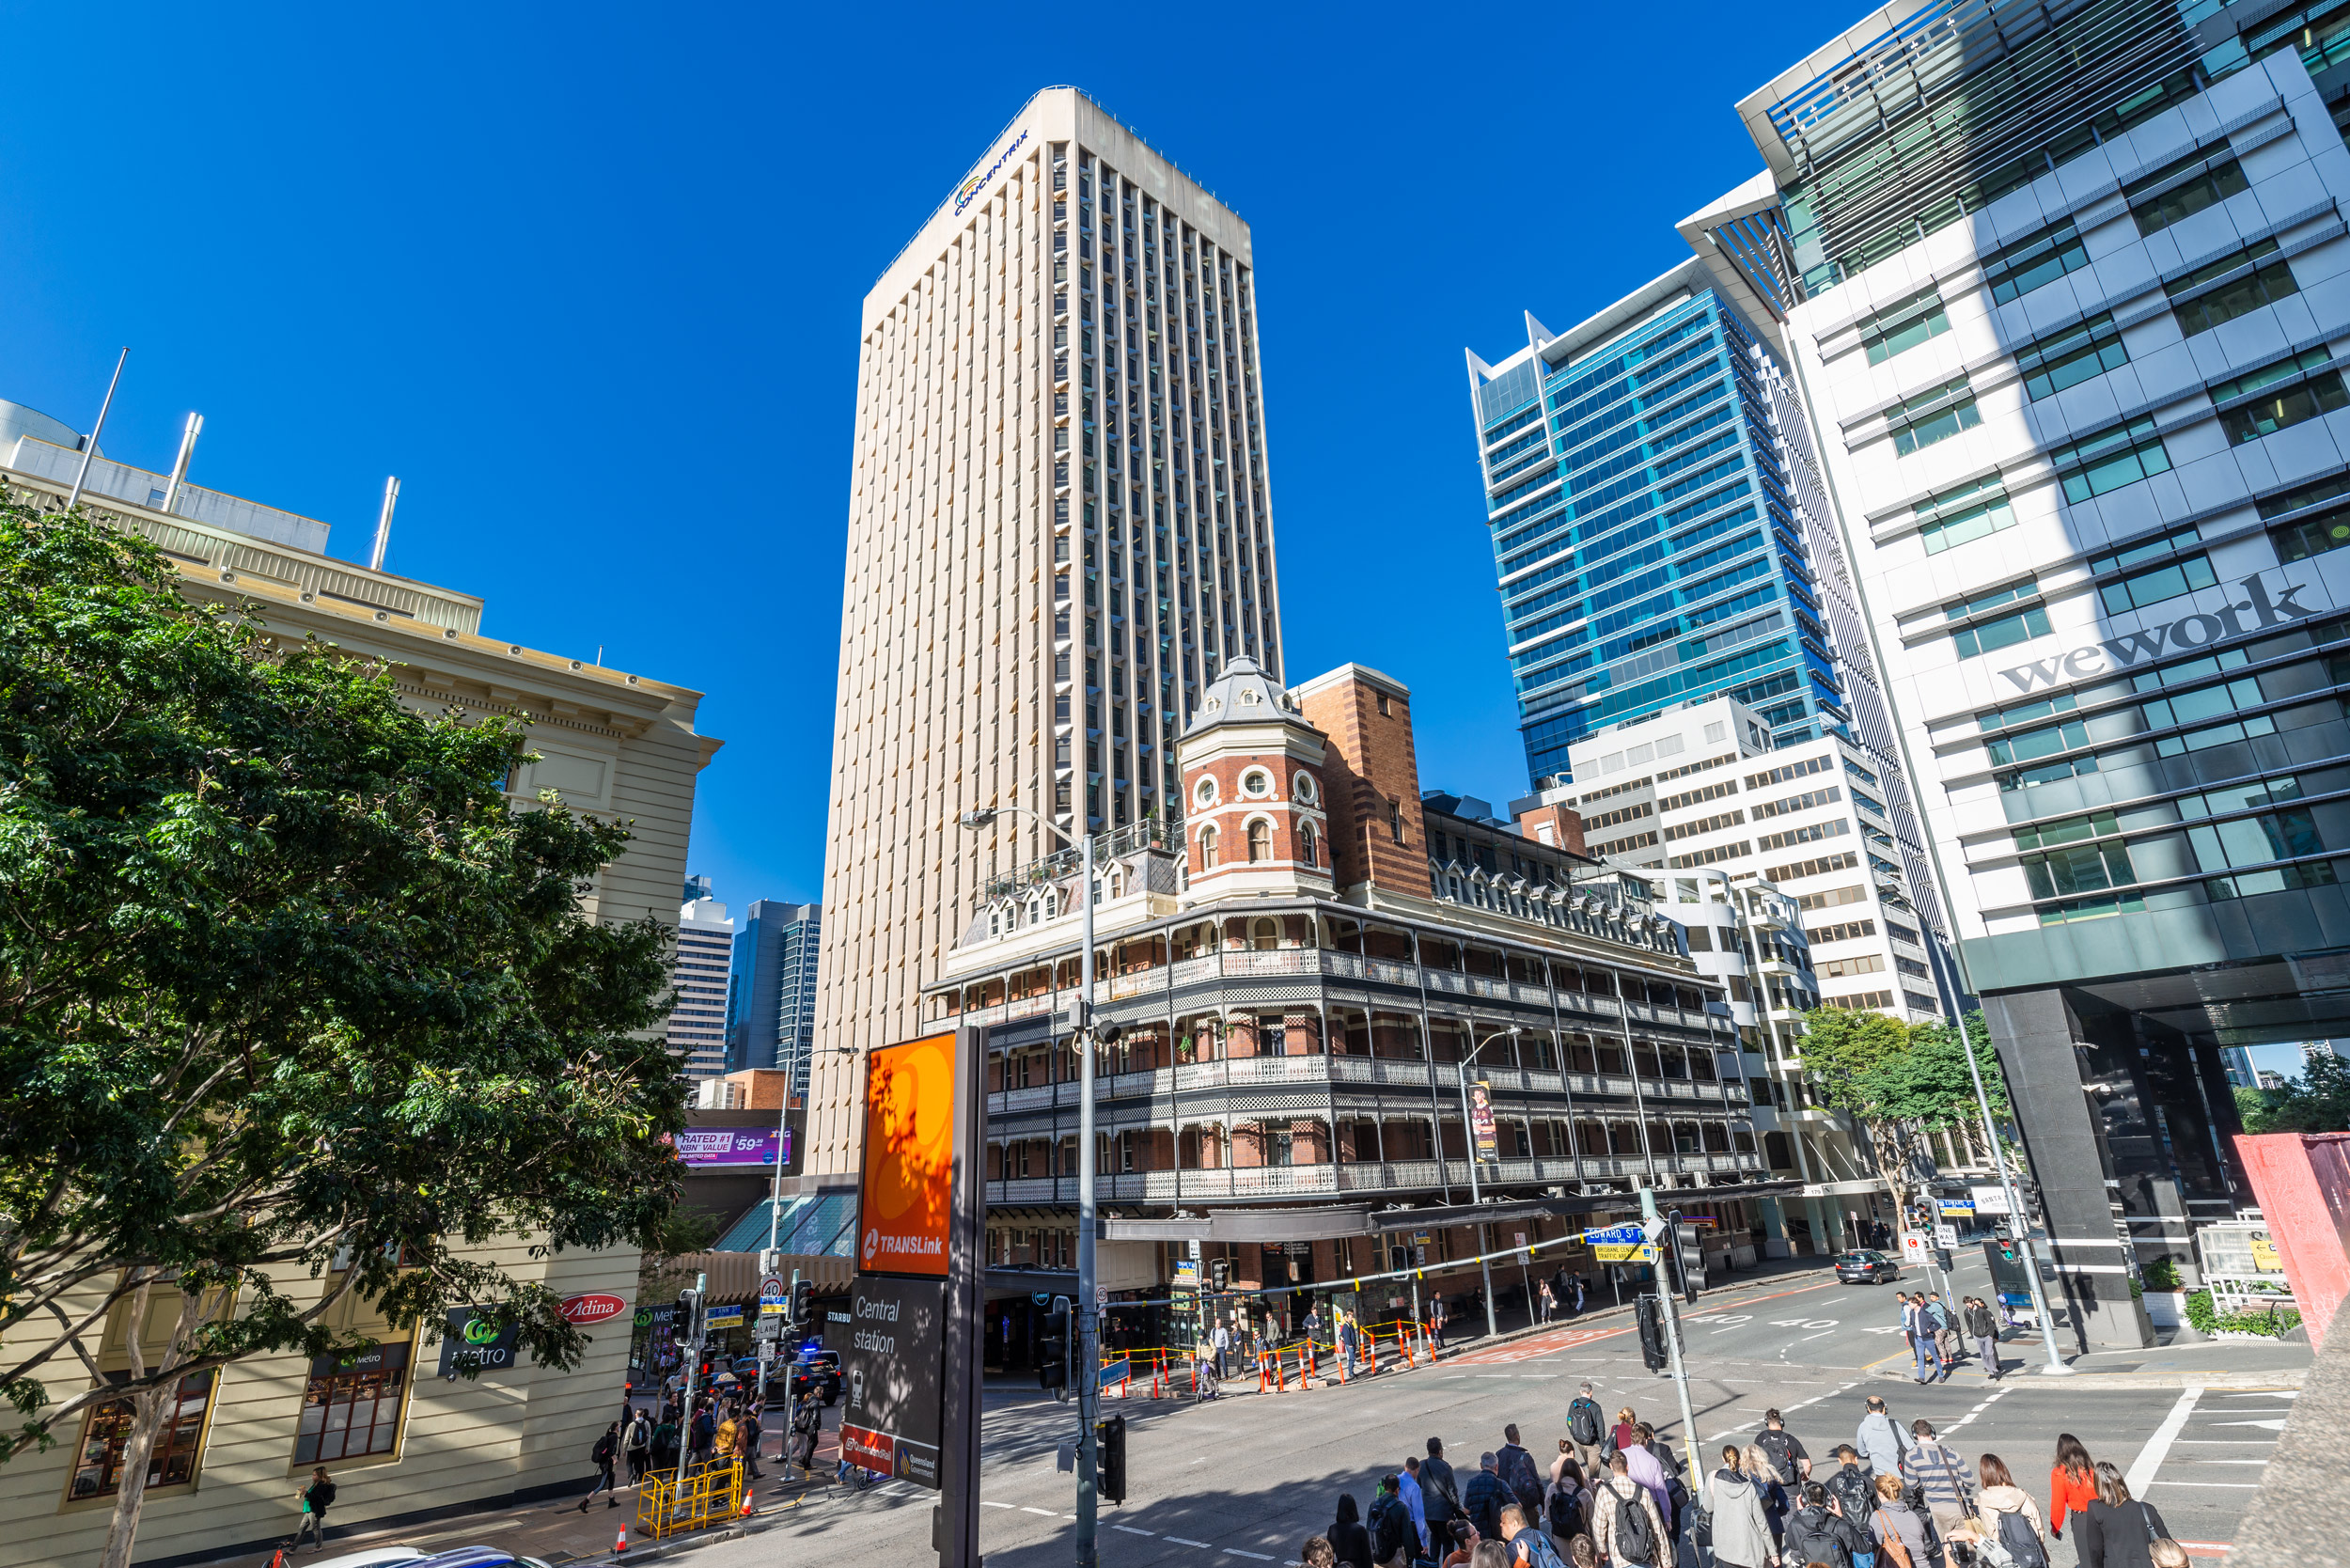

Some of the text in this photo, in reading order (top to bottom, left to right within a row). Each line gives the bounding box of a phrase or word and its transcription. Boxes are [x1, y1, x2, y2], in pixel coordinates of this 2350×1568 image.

[955, 130, 1027, 216] CONCENTRIX
[1998, 572, 2322, 693] wework
[682, 1135, 730, 1143] RATED #1
[1981, 1195, 2002, 1204] SANTA
[1626, 1229, 1634, 1238] ST
[881, 1235, 943, 1255] TRANSLink
[764, 1285, 778, 1295] 40
[561, 1300, 615, 1318] Adina
[653, 1309, 678, 1323] Met
[856, 1295, 901, 1323] Central
[827, 1311, 851, 1324] STARBU
[1767, 1318, 1840, 1329] 40
[760, 1325, 777, 1334] LANE
[854, 1328, 895, 1354] station
[356, 1354, 381, 1364] Metro
[909, 1453, 936, 1469] Queensland
[910, 1464, 934, 1479] Government
